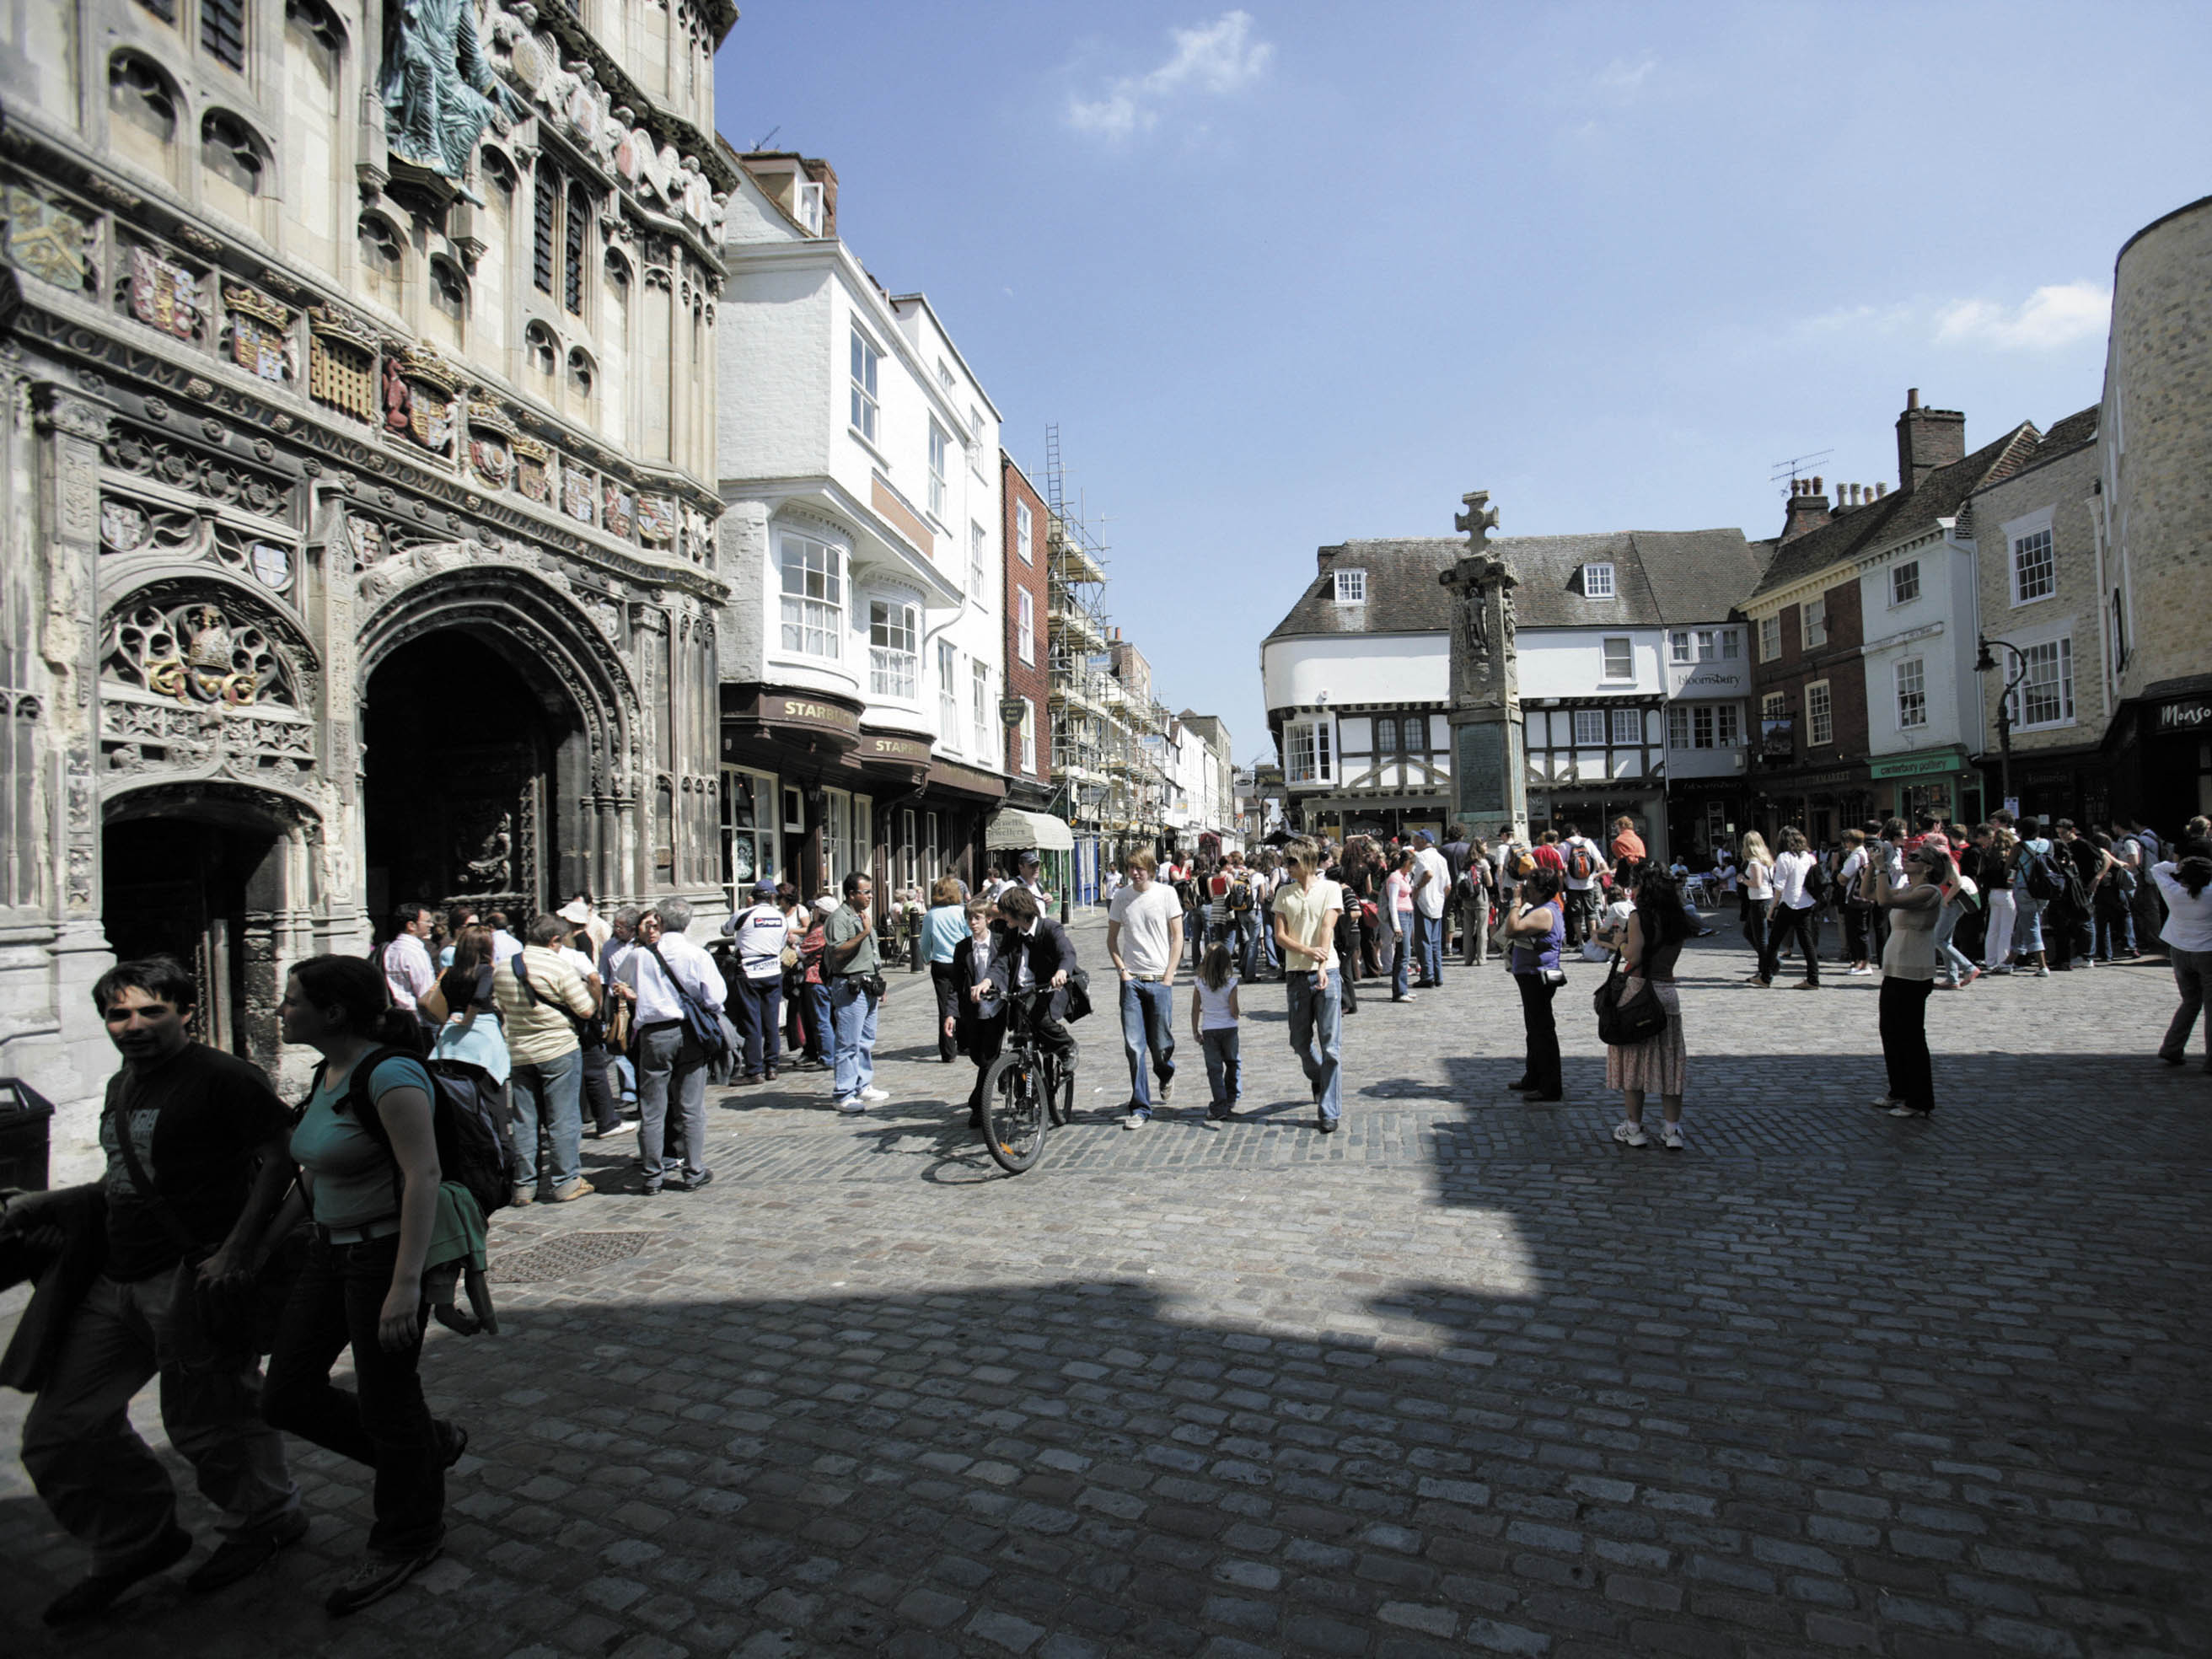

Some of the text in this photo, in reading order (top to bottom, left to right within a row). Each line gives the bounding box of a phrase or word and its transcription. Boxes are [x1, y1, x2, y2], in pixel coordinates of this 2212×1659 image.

[212, 386, 275, 422] EST
[283, 423, 368, 464] ANNO
[384, 457, 465, 503] DOMINI
[479, 498, 575, 550] MILLESIMO
[1678, 673, 1741, 688] bloomsbury
[2161, 705, 2211, 727] Monso
